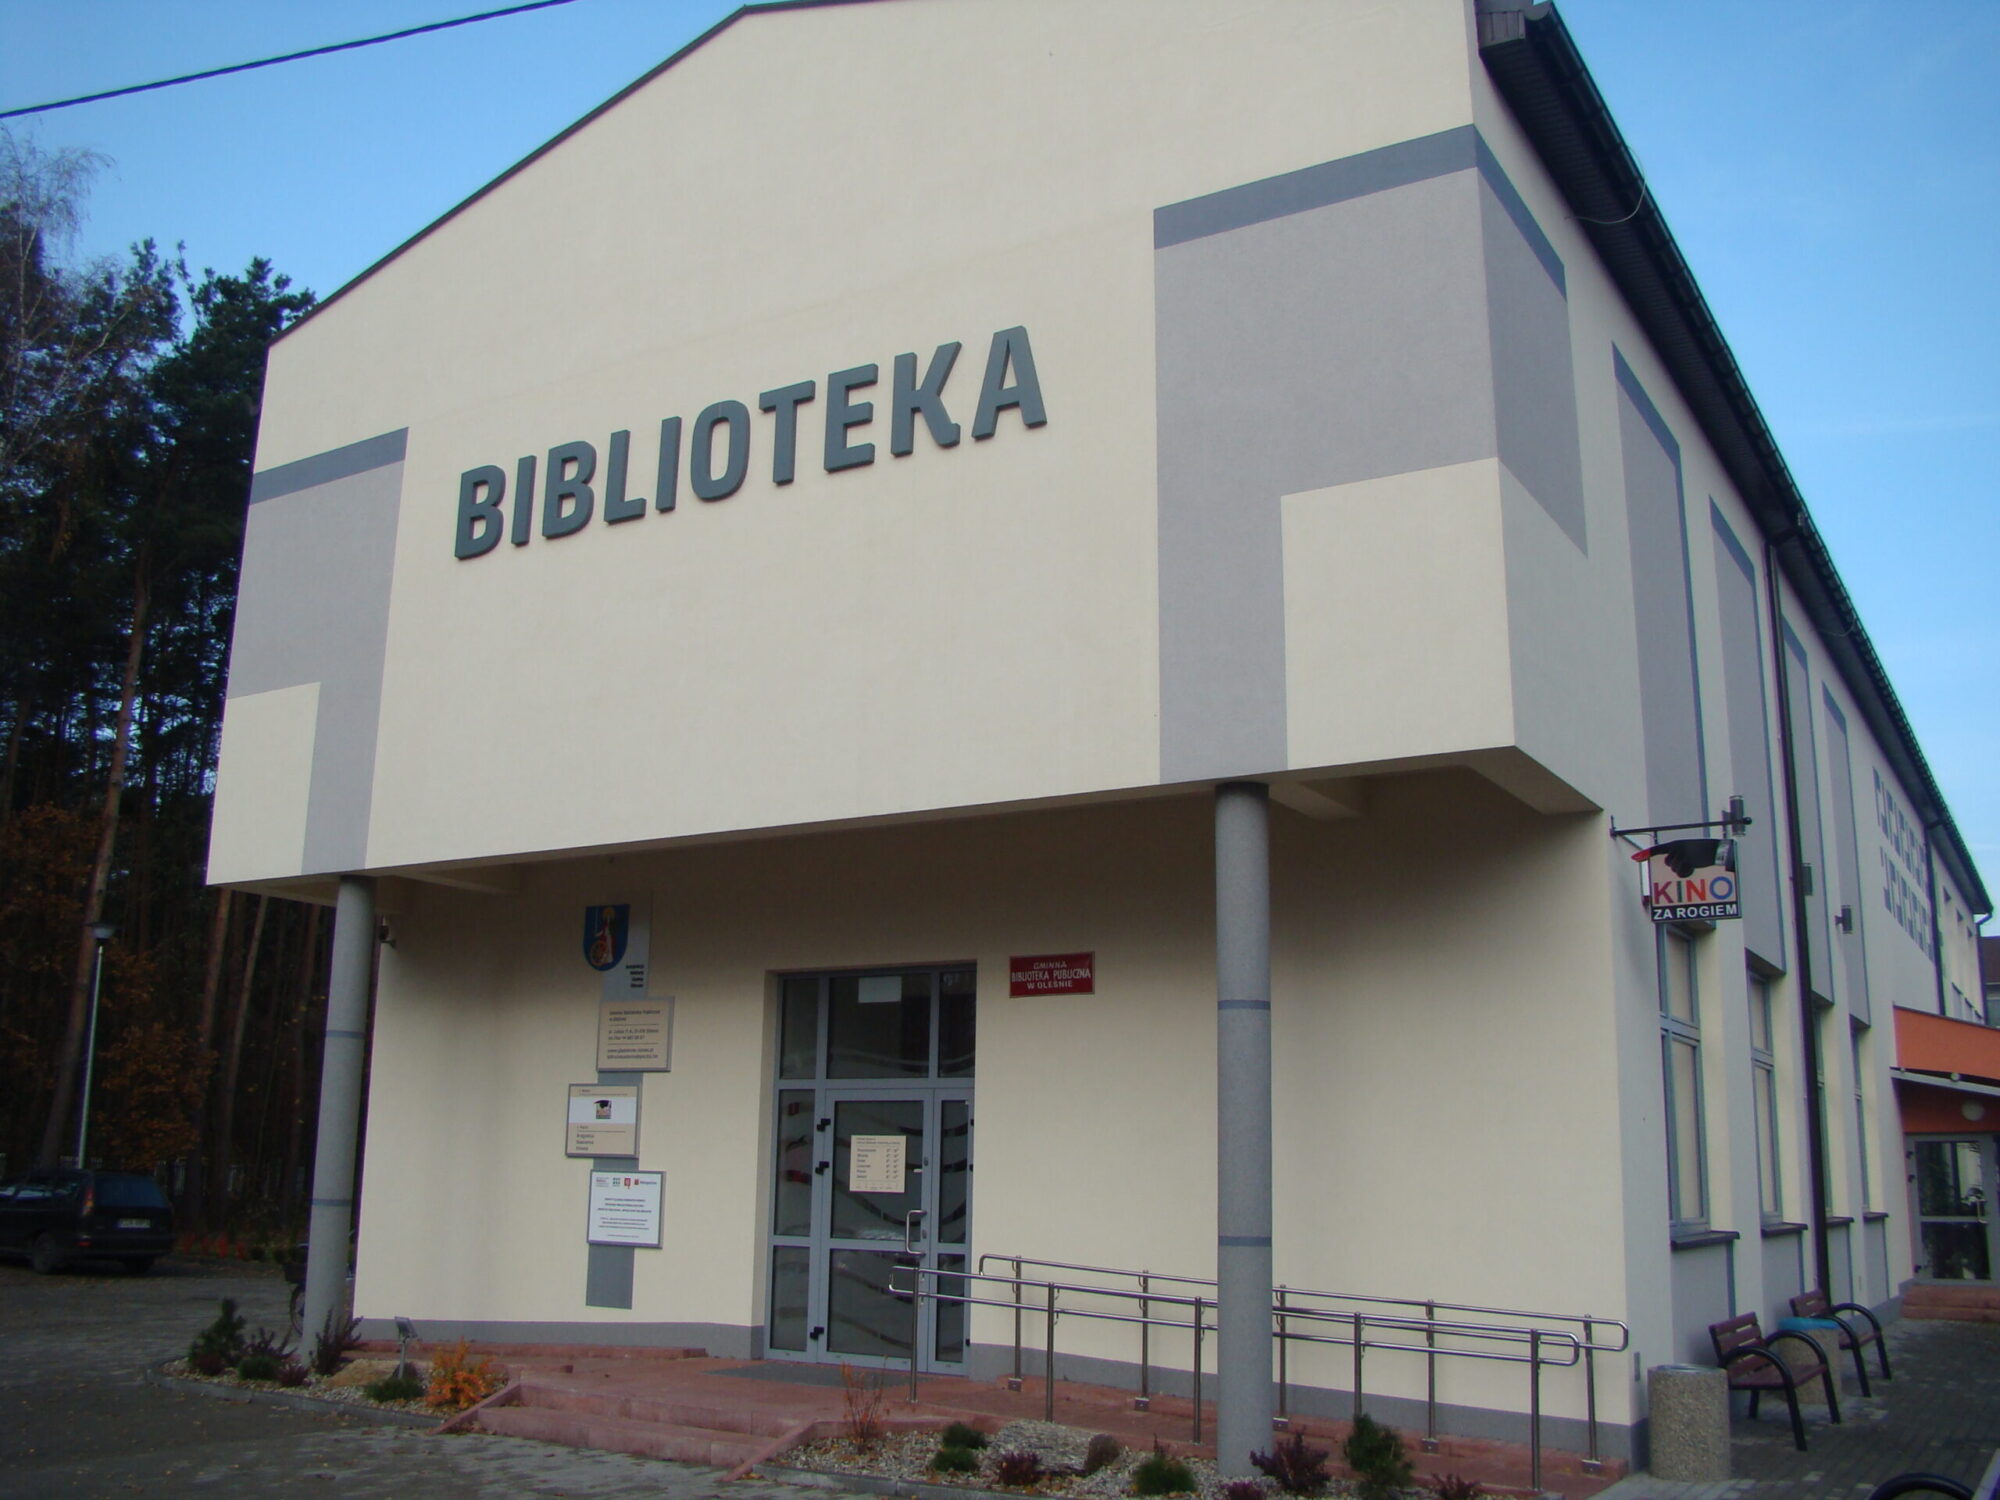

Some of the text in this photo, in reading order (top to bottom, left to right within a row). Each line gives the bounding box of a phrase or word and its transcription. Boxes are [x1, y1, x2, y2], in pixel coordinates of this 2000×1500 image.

[454, 325, 1048, 561] BIBLIOTEKA
[1653, 876, 1734, 905] KINO
[1653, 904, 1738, 920] ZA ROGIEM
[1033, 961, 1068, 970] GMINNA
[1011, 968, 1091, 982] BIBLIOTEKA PUBLICZNA
[1026, 982, 1035, 990] W
